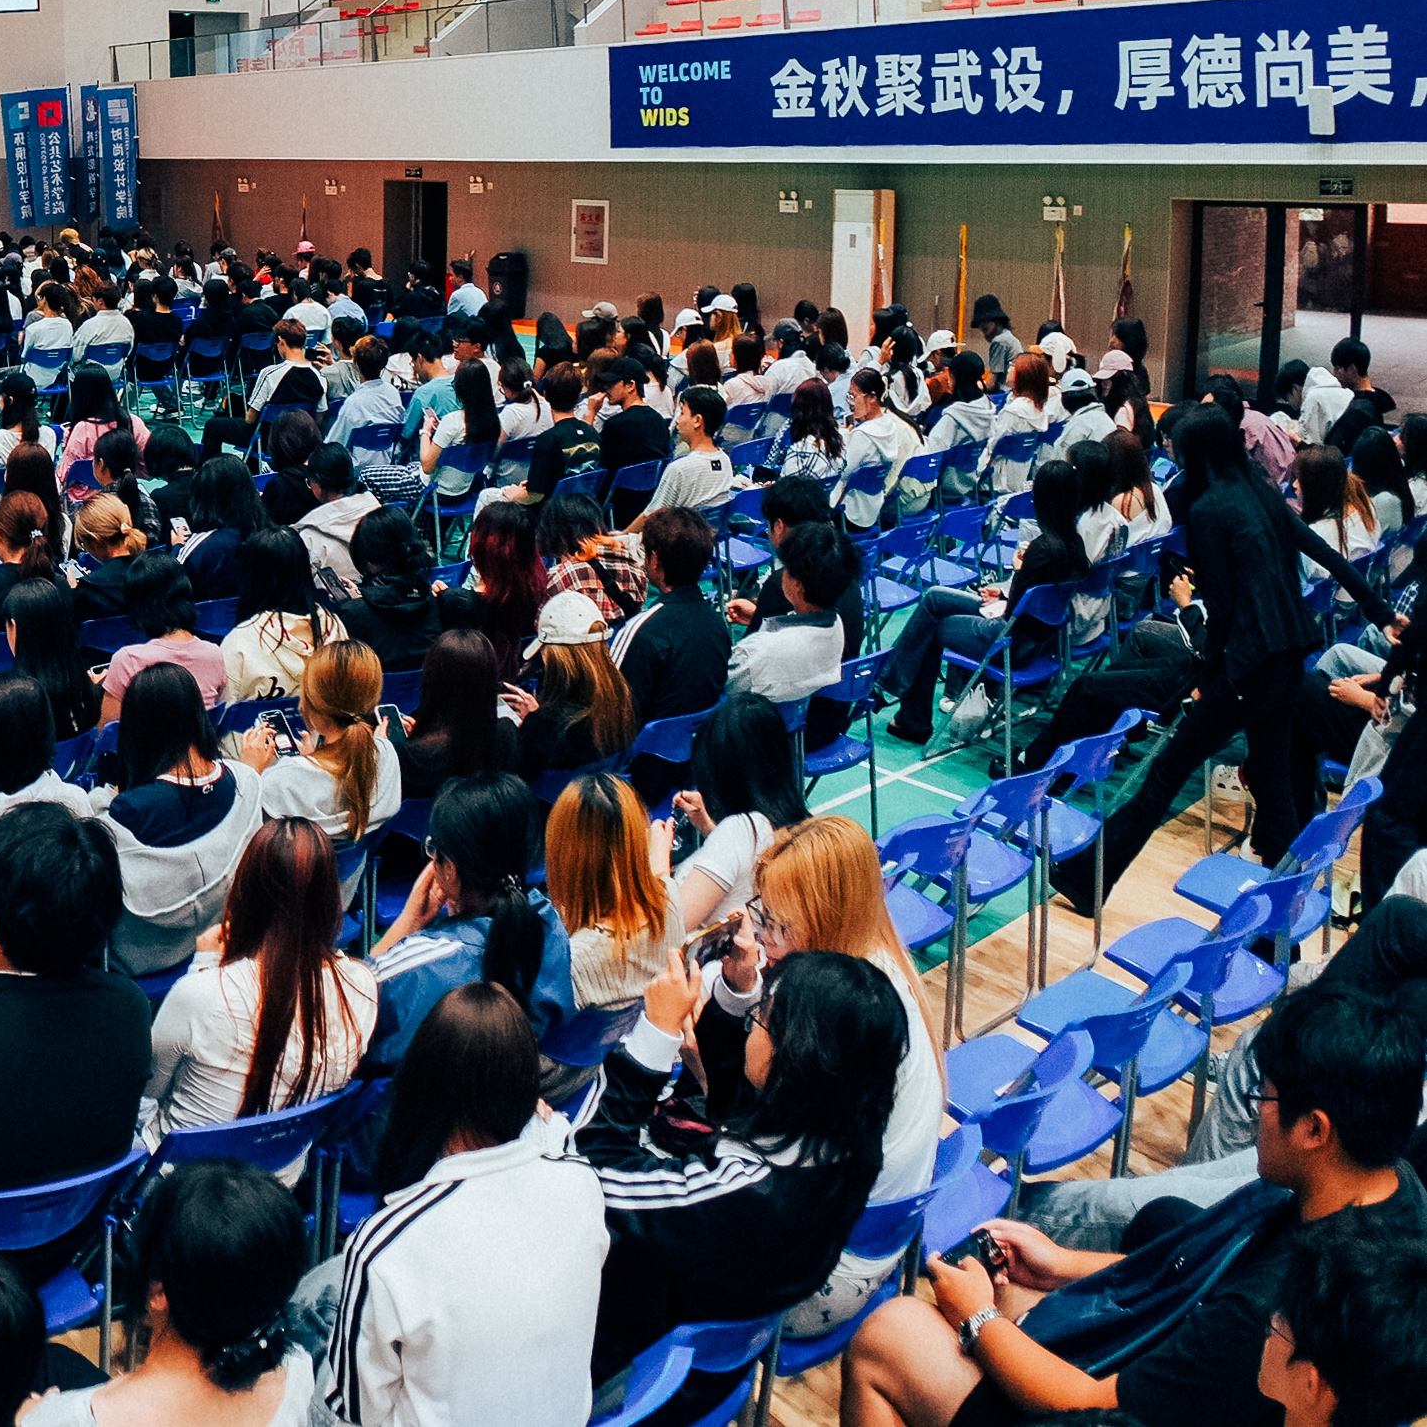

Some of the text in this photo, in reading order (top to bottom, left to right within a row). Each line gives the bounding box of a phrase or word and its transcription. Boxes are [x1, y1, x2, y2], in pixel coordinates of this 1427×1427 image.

[638, 60, 732, 84] WELCOME
[639, 86, 663, 105] TO
[640, 107, 690, 126] WIDS
